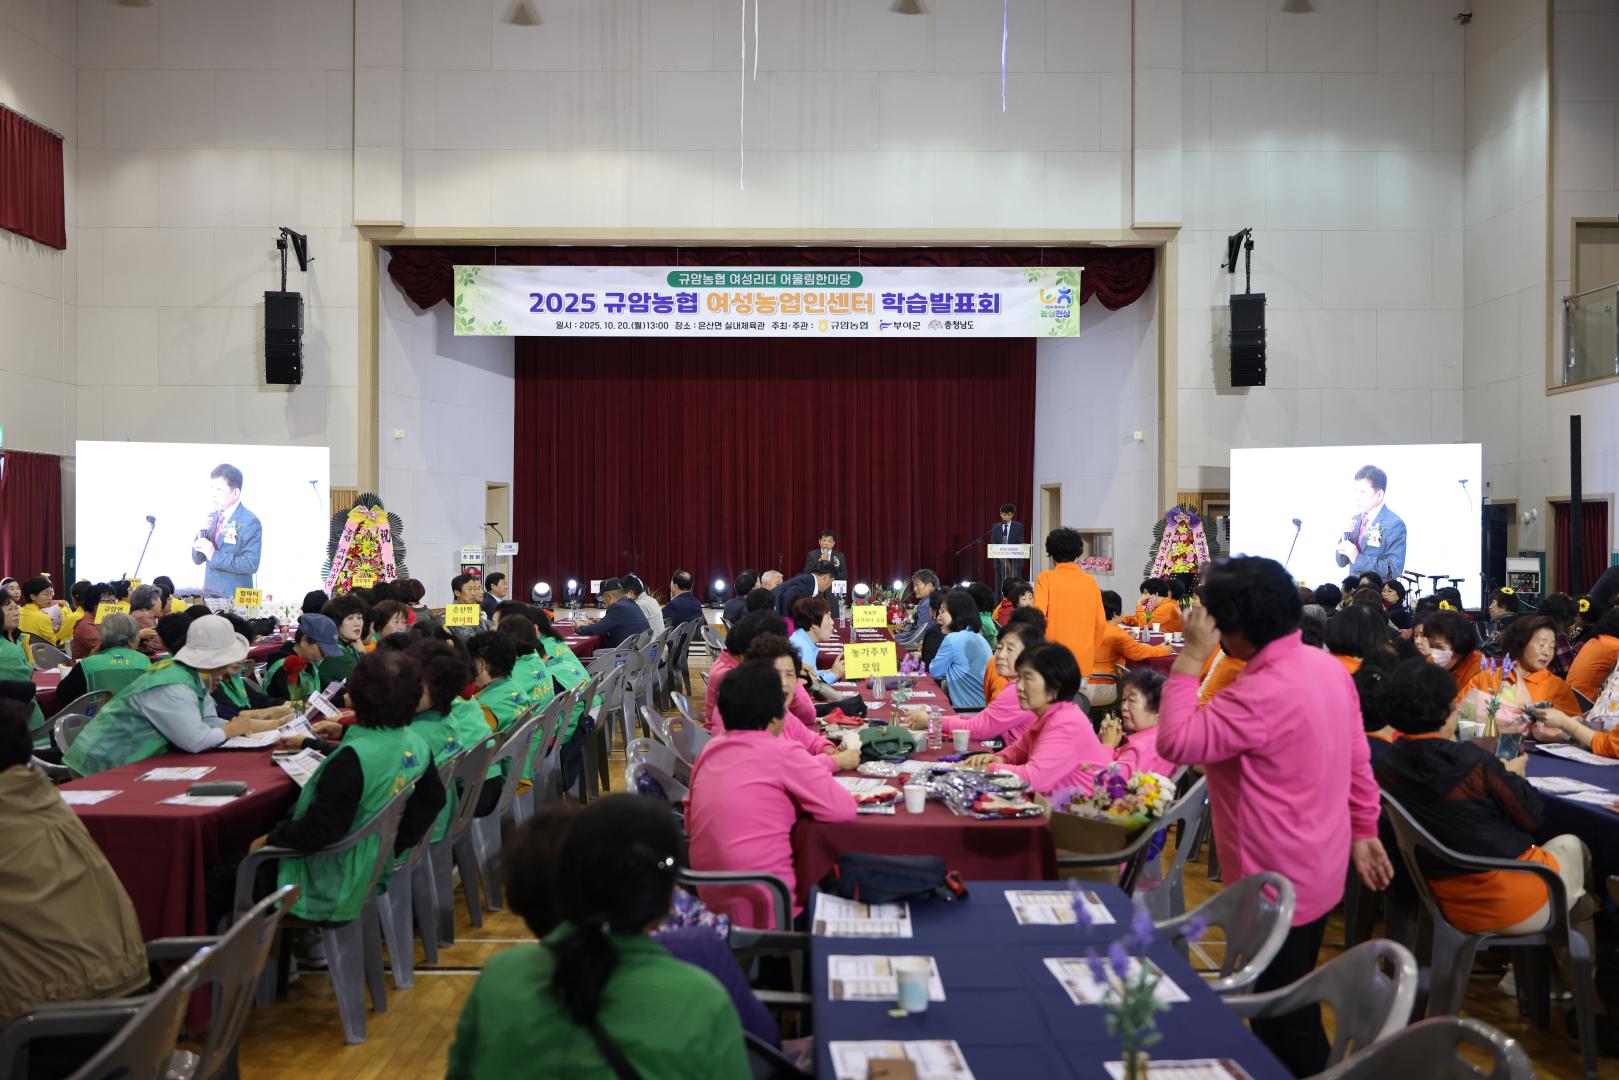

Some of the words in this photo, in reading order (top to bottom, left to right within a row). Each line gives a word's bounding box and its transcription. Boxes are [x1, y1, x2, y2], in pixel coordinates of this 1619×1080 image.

[678, 272, 726, 286] 규암농협
[729, 272, 777, 286] 여성리더
[780, 272, 852, 286] 어울림한마당
[529, 291, 597, 314] 2025
[603, 291, 699, 314] 규암농협
[706, 292, 873, 315] 여성농업인센터
[881, 292, 1001, 315] 학습발표회
[556, 321, 572, 330] 일시
[579, 321, 602, 330] 2025.
[604, 321, 616, 330] 10.
[675, 321, 691, 330] 장소
[698, 321, 722, 330] 은산면
[725, 321, 766, 330] 실내체육관
[831, 321, 869, 331] 규암농협
[893, 321, 921, 331] 부여군
[945, 320, 975, 331] 충청남도
[453, 606, 473, 614] 은산면
[452, 616, 473, 624] 부녀회
[851, 647, 888, 657] 농가주부
[862, 663, 880, 672] 모임
